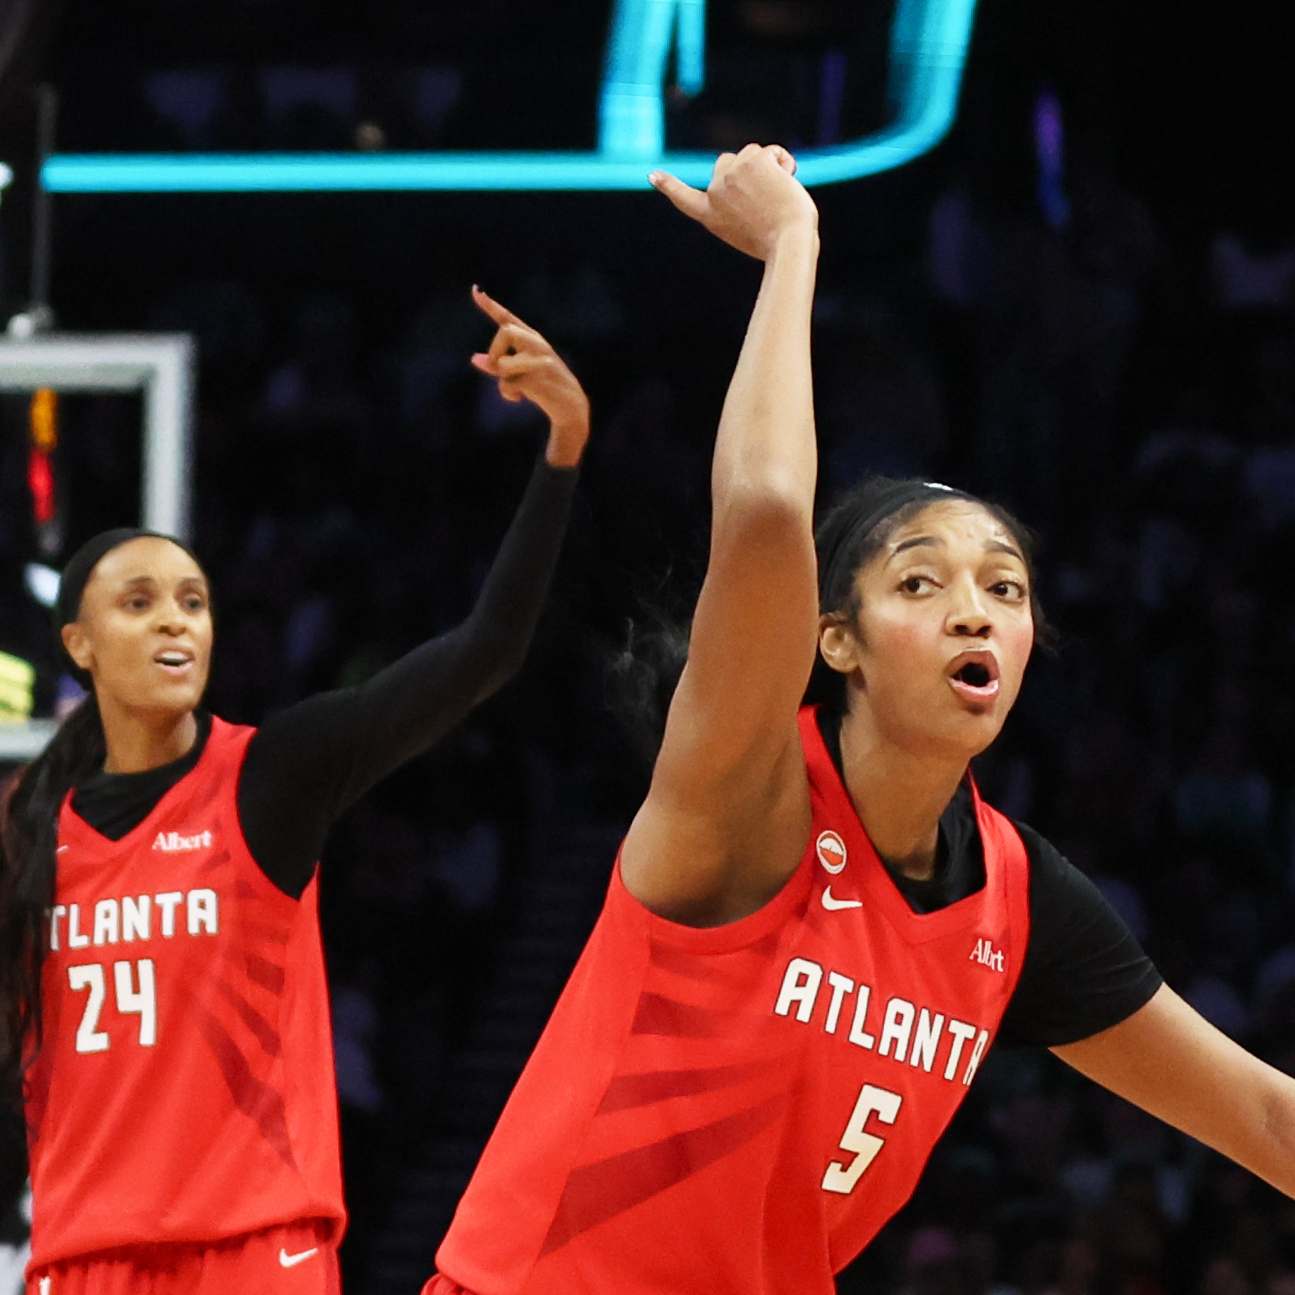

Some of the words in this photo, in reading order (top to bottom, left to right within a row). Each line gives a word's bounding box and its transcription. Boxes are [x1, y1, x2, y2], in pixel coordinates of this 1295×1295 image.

[152, 830, 211, 851] Albert
[47, 889, 219, 951] TLANTA
[67, 958, 156, 1053] 24
[774, 956, 989, 1087] ATLANTA
[821, 1083, 903, 1194] 5
